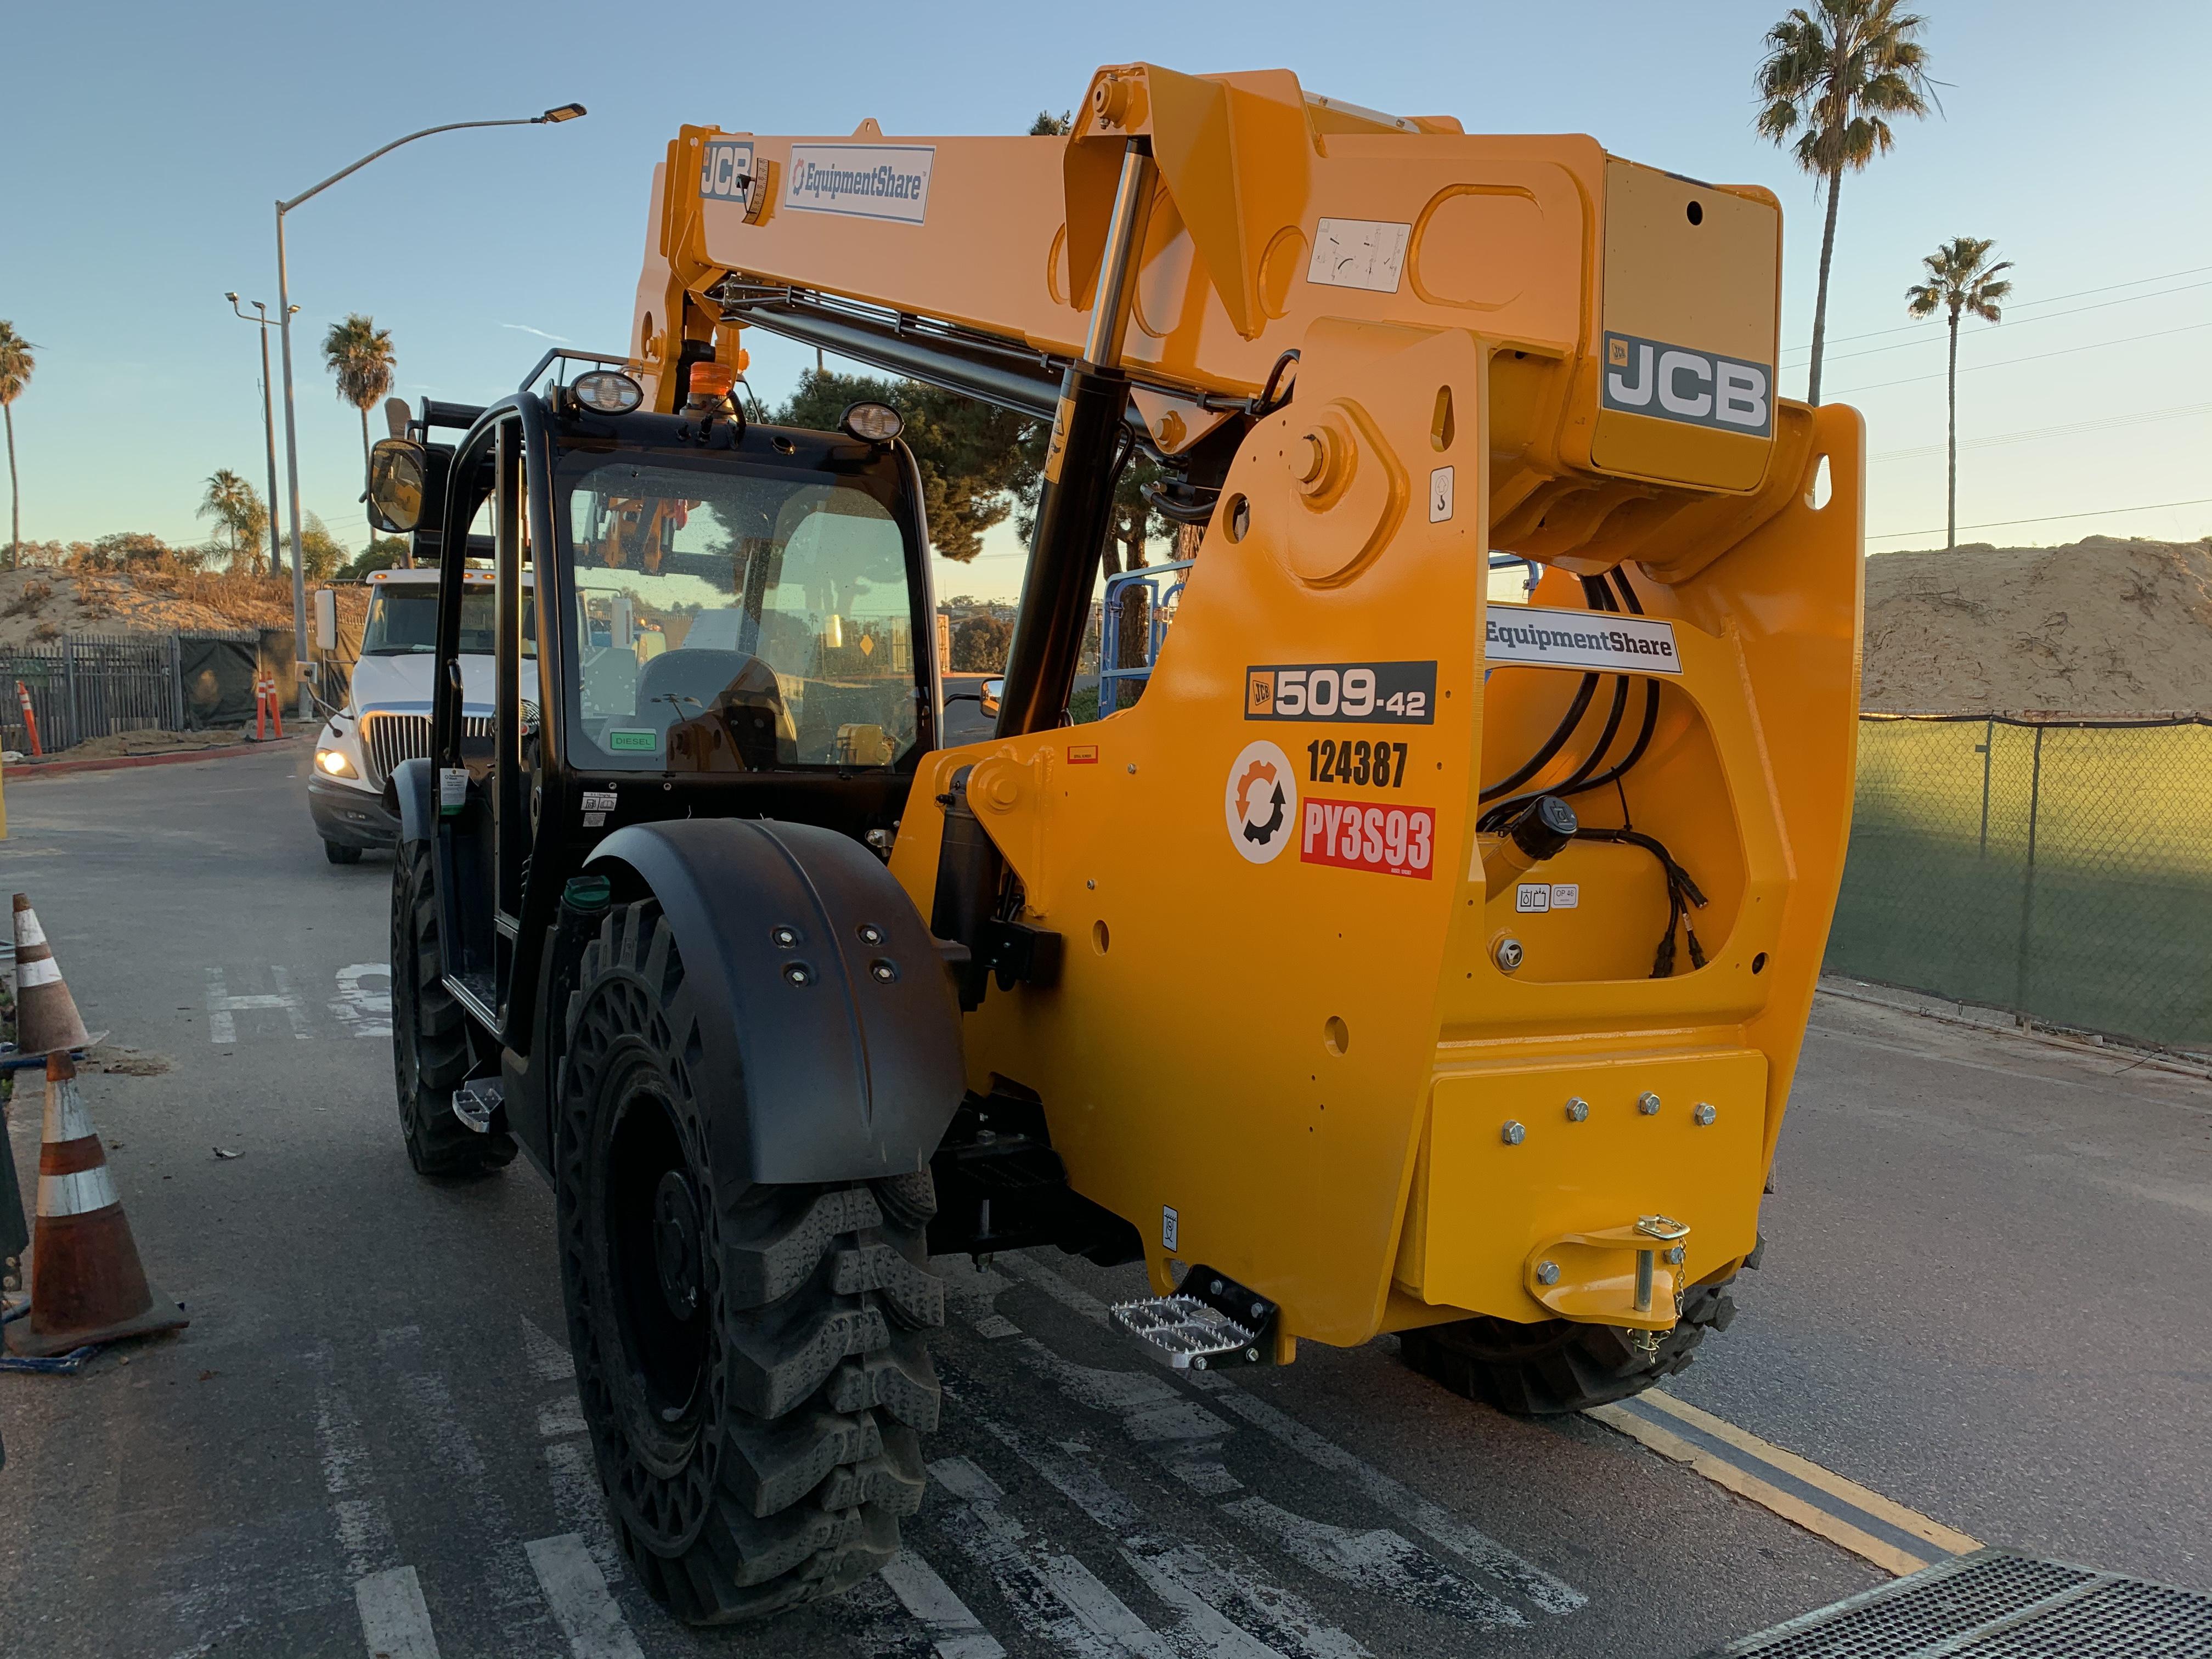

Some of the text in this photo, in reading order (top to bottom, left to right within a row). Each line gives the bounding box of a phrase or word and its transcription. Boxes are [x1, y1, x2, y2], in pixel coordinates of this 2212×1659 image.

[701, 146, 751, 196] JCB
[805, 162, 922, 200] EquipmentShare
[1609, 344, 1767, 427] JCB
[1486, 620, 1672, 657] EquipmentShare
[1255, 683, 1270, 702] JCB
[1276, 668, 1426, 716] 509-42
[616, 737, 651, 746] DIESEL
[1307, 739, 1408, 788] 124387
[1304, 803, 1432, 870] PY3S93
